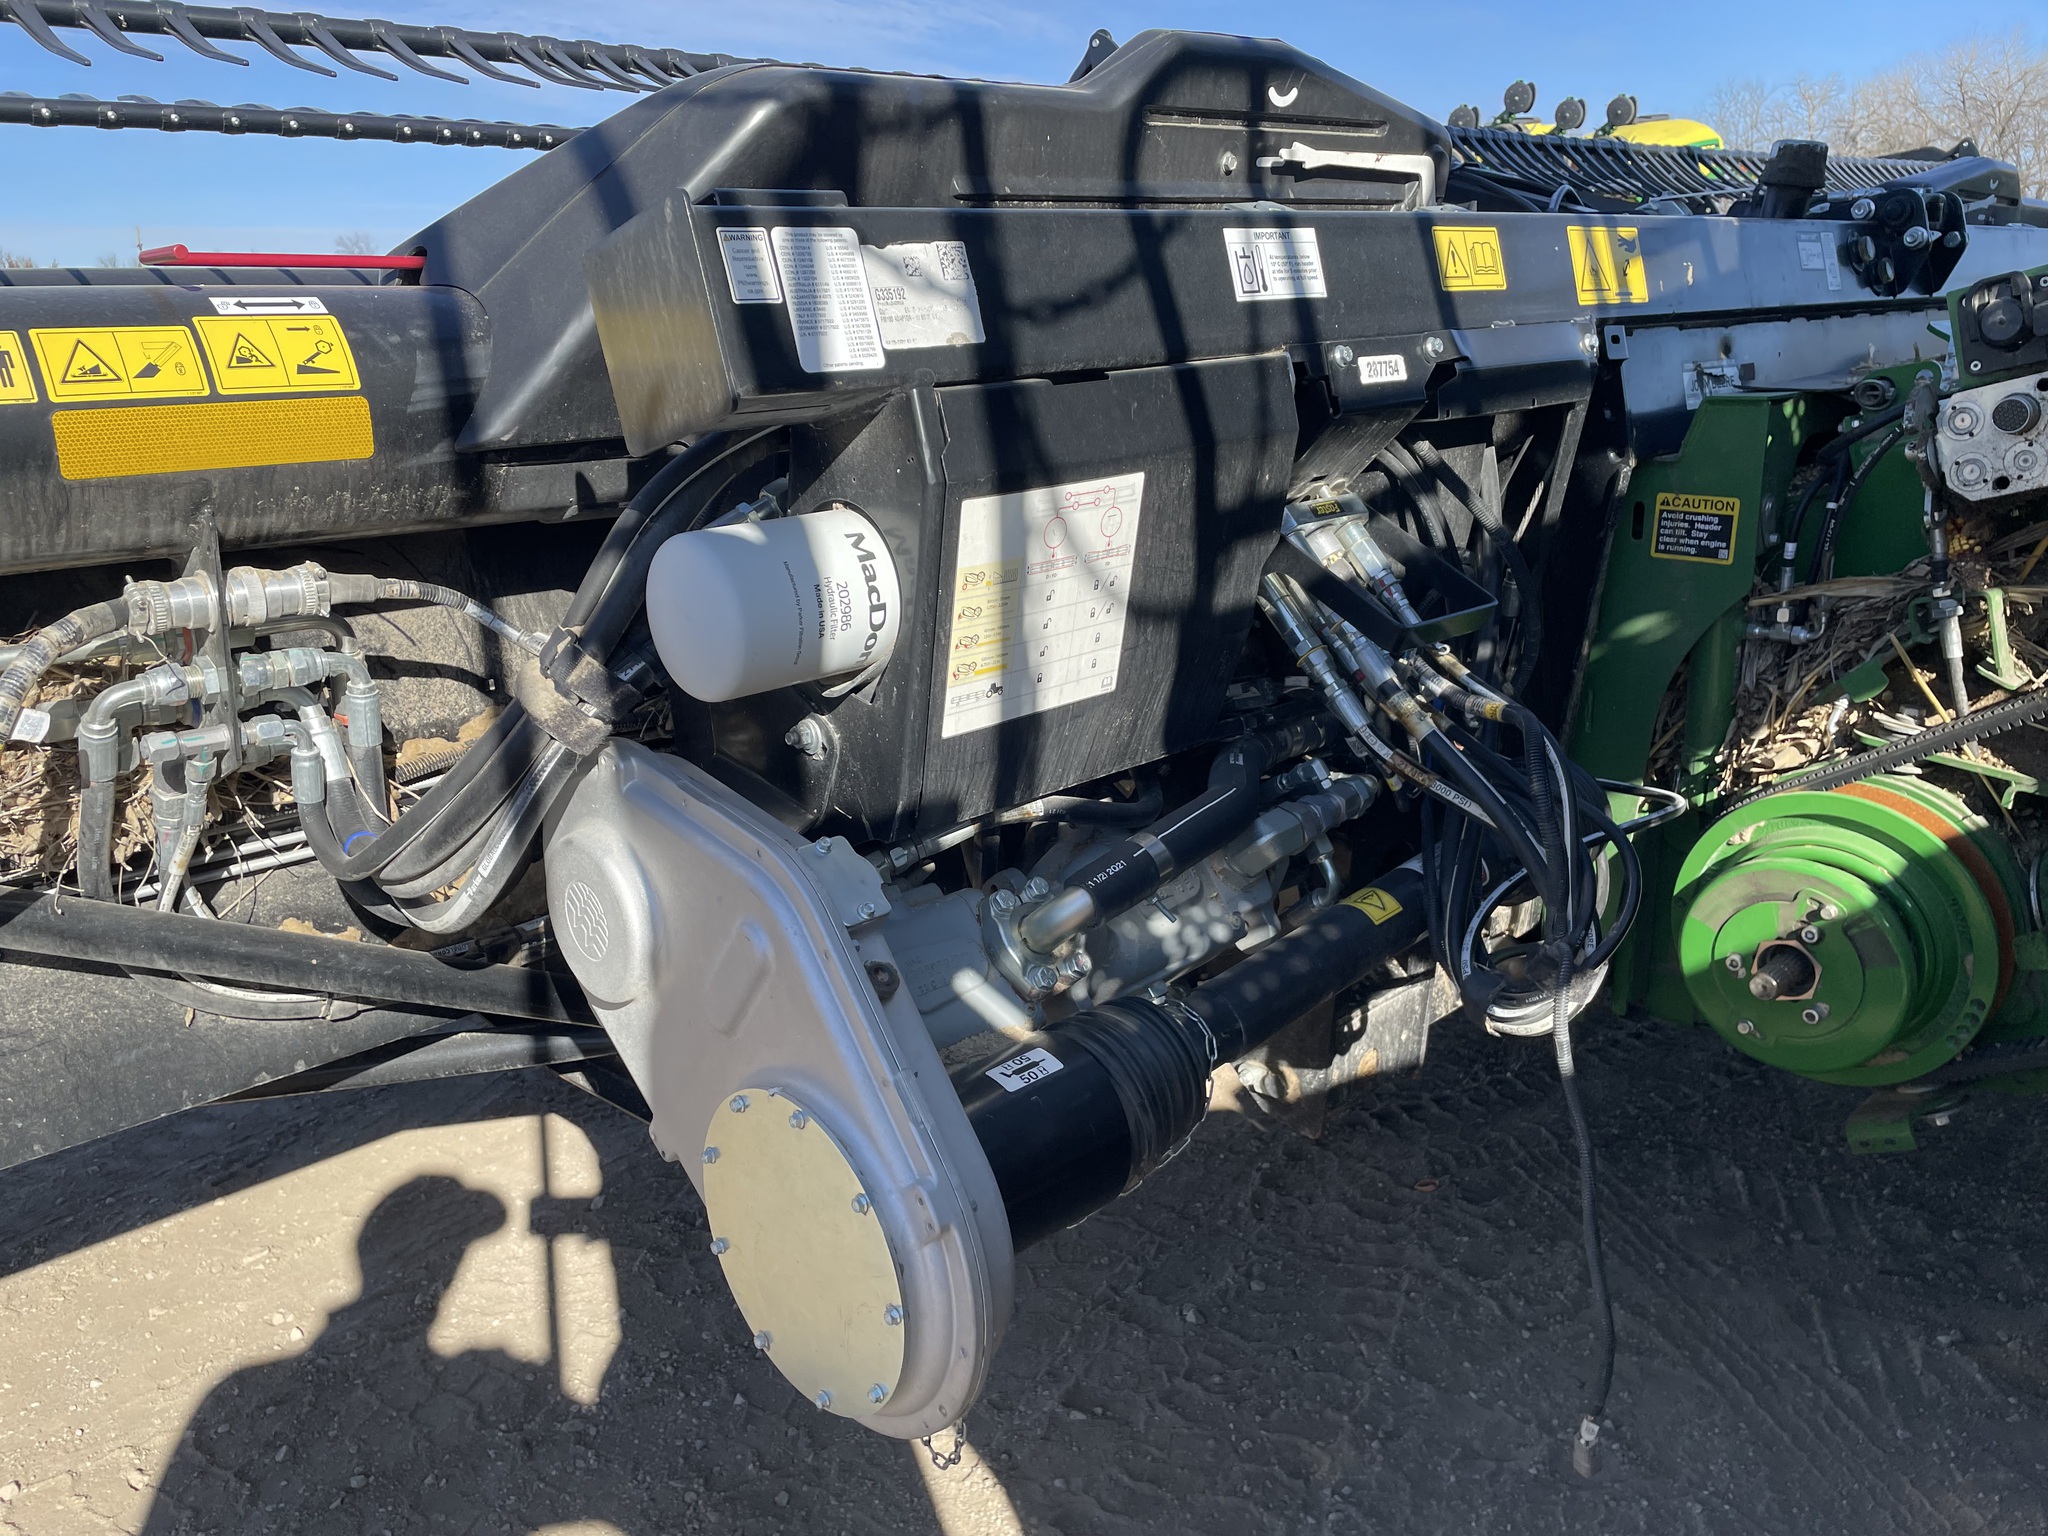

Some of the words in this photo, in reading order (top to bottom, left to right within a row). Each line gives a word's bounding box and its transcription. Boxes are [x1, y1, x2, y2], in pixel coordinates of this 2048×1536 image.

[1253, 232, 1290, 240] IMPORTANT
[875, 288, 906, 300] G335192
[1317, 503, 1341, 514] Faster
[1672, 497, 1735, 511] CAUTION
[1661, 519, 1690, 528] injuries.
[1695, 523, 1722, 531] Header
[1685, 514, 1718, 524] crushing
[1691, 530, 1708, 539] Stay
[1679, 537, 1699, 545] when
[1701, 540, 1726, 548] engine
[1667, 545, 1697, 554] running.
[783, 561, 800, 598] Manufactured
[796, 599, 800, 607] by
[814, 584, 822, 609] Made
[818, 610, 823, 618] in
[836, 581, 852, 631] 202986
[844, 532, 886, 667] MacDon
[824, 576, 836, 617] Hydraulic
[830, 619, 838, 640] Filter
[1452, 793, 1472, 808] PSI)
[1106, 860, 1127, 875] 2021
[466, 873, 483, 896] Parker
[1012, 1055, 1032, 1066] 50
[1019, 1071, 1039, 1084] 50
